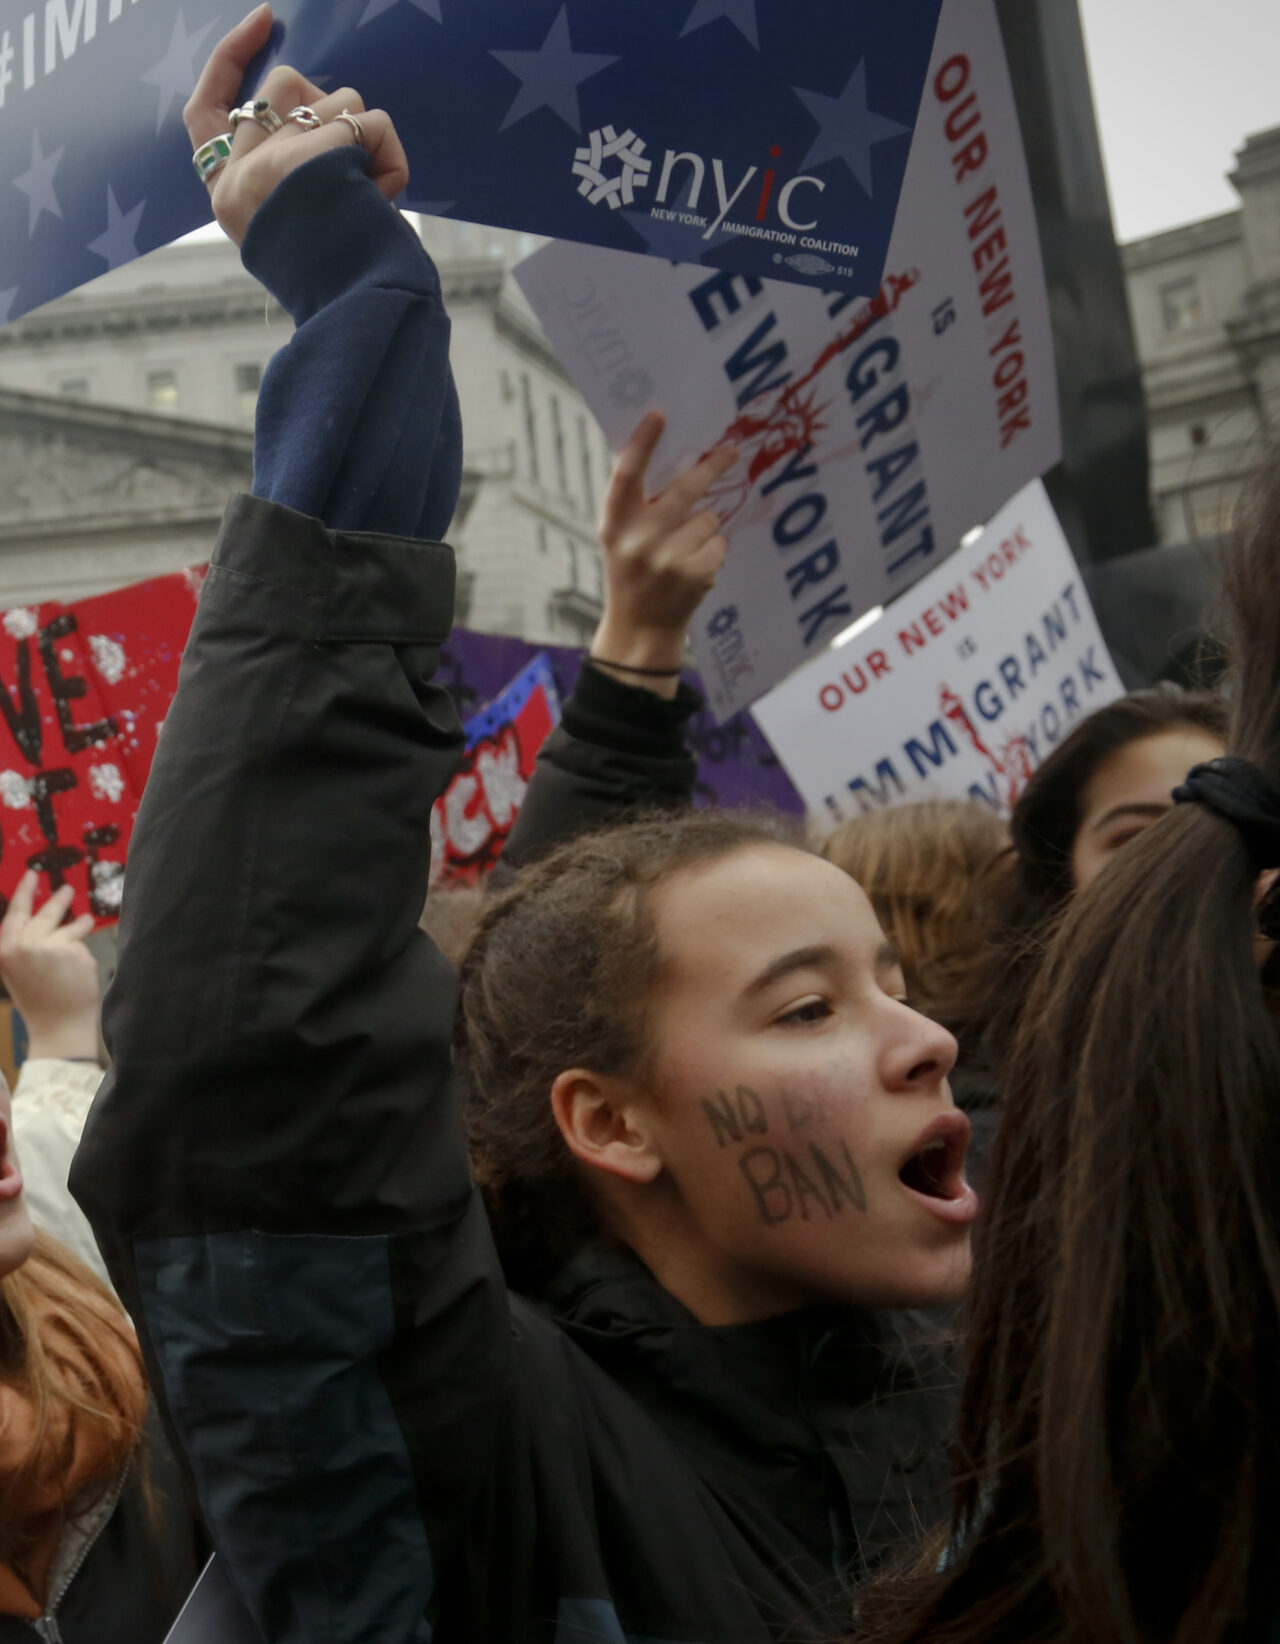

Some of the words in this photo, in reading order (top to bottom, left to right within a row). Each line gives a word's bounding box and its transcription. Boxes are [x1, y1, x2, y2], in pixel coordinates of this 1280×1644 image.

[933, 53, 988, 184] OUR
[651, 207, 677, 221] NEW
[678, 212, 707, 228] YORK
[722, 221, 796, 246] IMMIGRATION
[800, 236, 859, 257] COALITION
[655, 145, 826, 240] nyic
[964, 185, 1016, 317] NEW
[931, 297, 956, 336] IS
[989, 319, 1031, 450] YORK
[689, 268, 793, 411] EW
[761, 444, 852, 648] YORK
[819, 650, 892, 711] OUR
[898, 584, 969, 655] NEW
[971, 524, 1031, 591] YORK
[701, 1085, 768, 1148] NO
[738, 1140, 867, 1225] BAN
